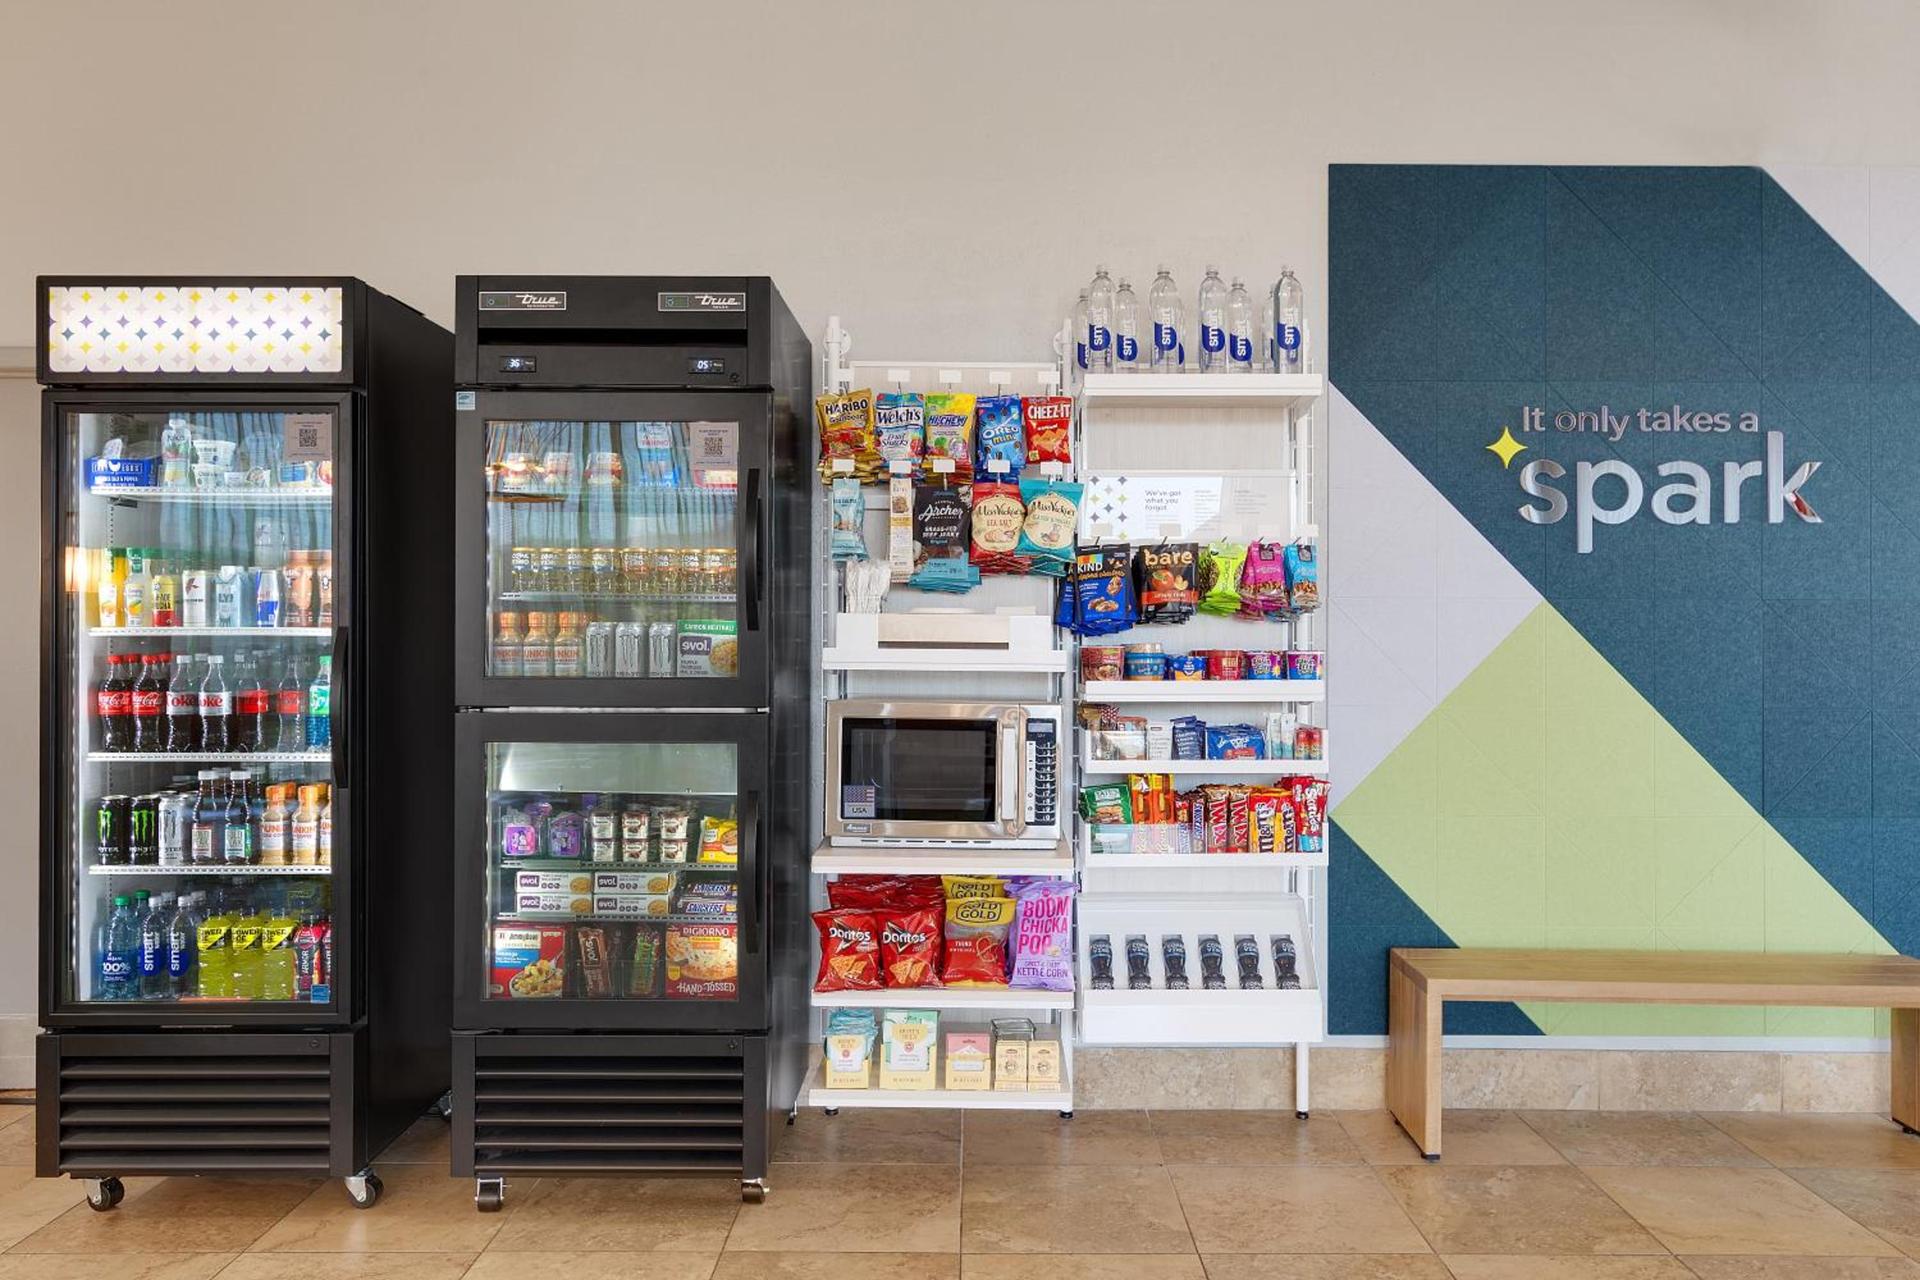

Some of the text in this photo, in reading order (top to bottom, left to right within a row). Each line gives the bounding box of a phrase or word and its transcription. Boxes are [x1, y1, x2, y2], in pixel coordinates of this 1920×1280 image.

[825, 399, 868, 415] HARIBO
[1027, 403, 1071, 419] CHEEZ-IT
[877, 408, 921, 424] Welch's
[1523, 406, 1759, 441] It only takes a
[982, 425, 1019, 439] OREO
[1519, 430, 1823, 553] spark
[918, 504, 963, 522] Archer
[1144, 549, 1193, 566] bare
[1077, 562, 1103, 573] KIND
[1210, 800, 1227, 845] TWIX
[1230, 800, 1248, 844] TWIX
[687, 903, 724, 913] SNICKERS
[960, 909, 997, 919] GOLD
[1023, 896, 1069, 918] BOOM
[683, 927, 729, 936] DIGIORNO
[1021, 918, 1068, 933] CHICKA
[829, 927, 871, 941] Doritos
[882, 932, 927, 944] Doritos
[143, 931, 154, 971] smart
[170, 931, 179, 971] smart
[1018, 934, 1051, 955] POP
[103, 962, 131, 972] 100%
[1017, 968, 1068, 978] KETTLE CORN
